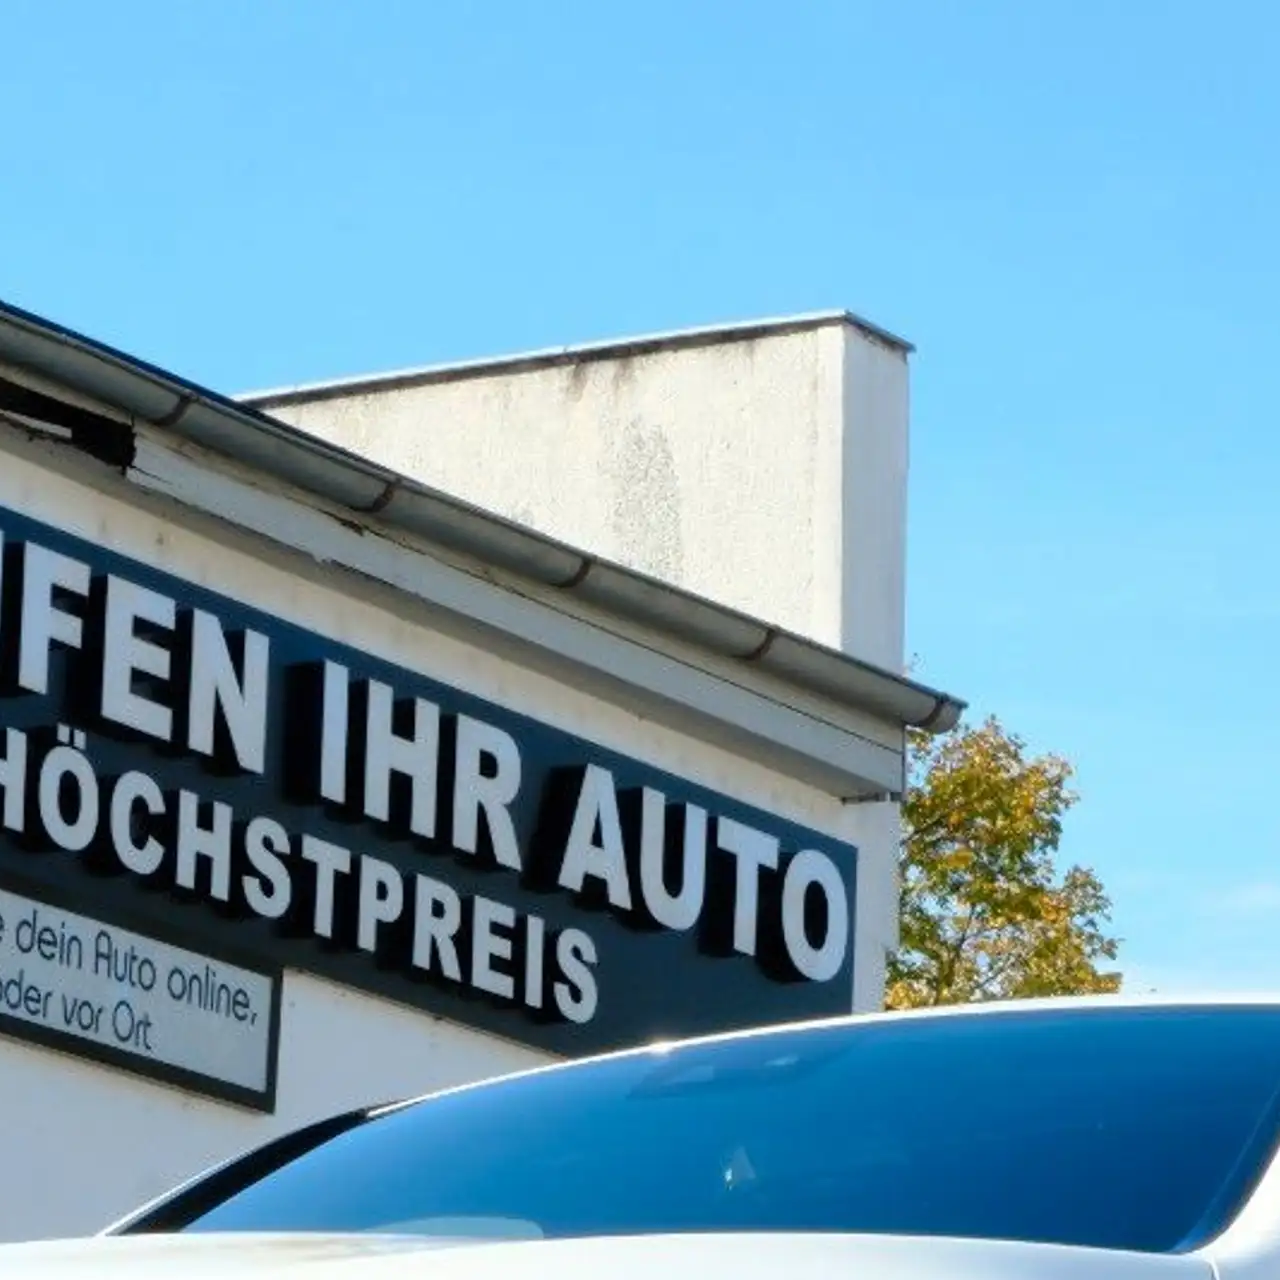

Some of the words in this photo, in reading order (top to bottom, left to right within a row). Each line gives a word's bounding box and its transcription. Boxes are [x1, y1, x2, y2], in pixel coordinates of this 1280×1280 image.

[322, 659, 522, 871] IHR
[558, 763, 848, 982] AUTO
[15, 909, 83, 969] dein
[94, 930, 156, 992] Auto
[167, 964, 257, 1026] online,
[61, 995, 103, 1033] vor
[112, 1001, 152, 1051] Ort
